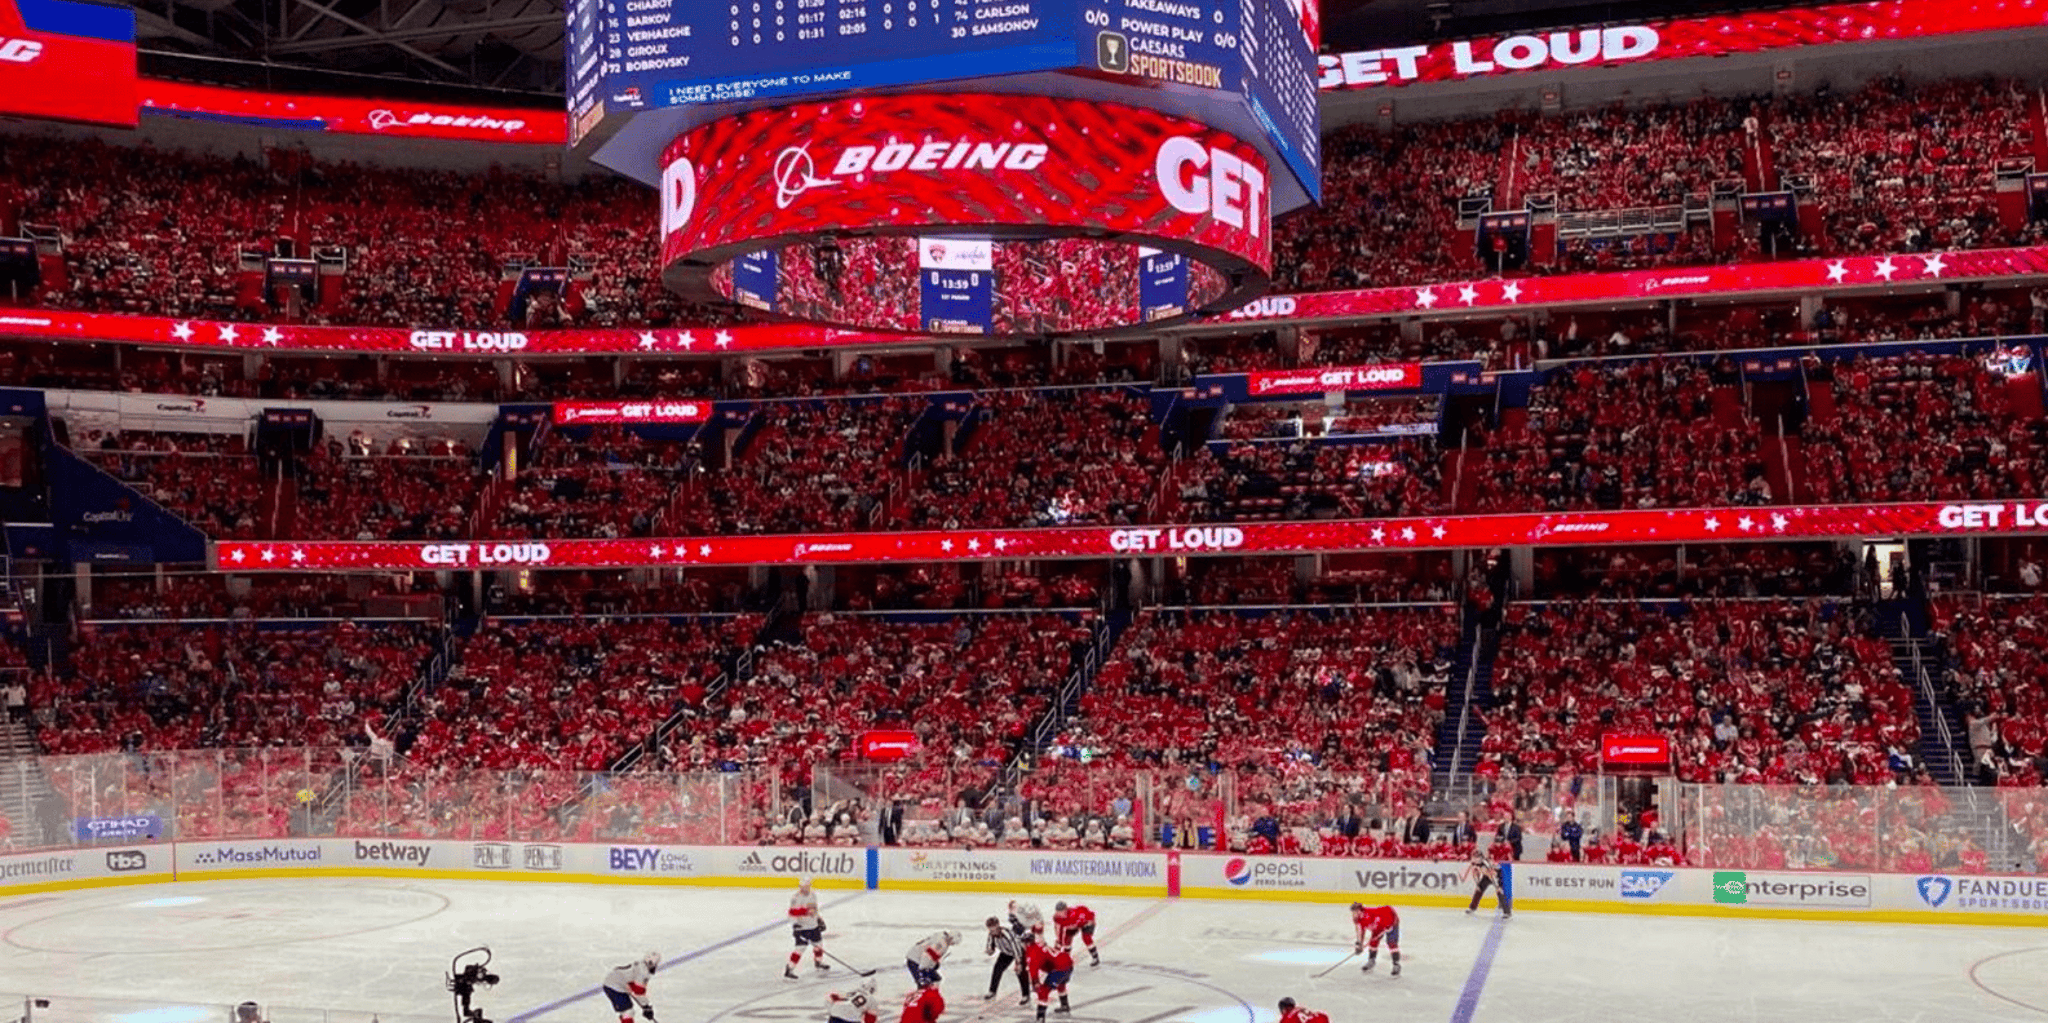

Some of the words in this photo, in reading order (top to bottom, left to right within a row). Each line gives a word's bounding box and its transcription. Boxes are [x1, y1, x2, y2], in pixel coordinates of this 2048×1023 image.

[609, 33, 621, 44] 23
[731, 20, 739, 31] 0
[753, 18, 761, 28] 0
[776, 15, 784, 26] 0
[798, 12, 825, 24] 01:17
[839, 7, 866, 19] 02:16
[884, 3, 892, 14] 0
[908, 1, 916, 11] 0
[627, 13, 671, 27] BARKOV
[730, 5, 739, 15] 0
[752, 2, 760, 13] 0
[776, 0, 784, 10] 0
[731, 36, 739, 46] 0
[753, 33, 761, 44] 0
[777, 31, 784, 41] 0
[798, 27, 825, 39] 01:31
[839, 22, 866, 35] 02:05
[884, 19, 892, 30] 0
[908, 16, 917, 27] 0
[955, 11, 968, 22] 74
[975, 3, 1030, 19] CARLSON
[1213, 10, 1223, 23] 0
[1085, 10, 1109, 26] 0/0
[1121, 17, 1169, 37] POWER
[1172, 27, 1203, 43] PLAY
[1214, 33, 1236, 48] 0/0
[609, 63, 621, 74] 72
[626, 56, 690, 72] BOBROVSKY
[951, 26, 966, 38] 30
[972, 18, 1039, 36] SAMSONOV
[1130, 37, 1185, 58] CAESARS
[1453, 25, 1660, 74] LOUD
[1131, 54, 1221, 88] SPORTSBOOK
[676, 84, 712, 95] NEED
[792, 75, 810, 84] TO
[814, 71, 851, 82] MAKE
[409, 112, 525, 132] BOEING
[833, 142, 1049, 175] BOEING
[1156, 135, 1264, 238] GET
[942, 279, 969, 290] 13:59
[410, 331, 456, 349] GET
[464, 332, 528, 350] LOUD
[1321, 371, 1354, 385] GET
[1358, 369, 1404, 383] LOUD
[622, 404, 651, 417] GET
[656, 404, 698, 417] LOUD
[1939, 504, 2005, 528] GET
[1110, 529, 1161, 550] GET
[1169, 527, 1244, 548] LOUD
[421, 544, 471, 564] GET
[479, 543, 551, 563] LOUD
[109, 853, 144, 869] tbs
[217, 846, 321, 863] MassMutual
[355, 840, 430, 867] betway
[609, 848, 661, 871] BEVY
[661, 854, 689, 862] LONG
[771, 851, 854, 874] adiclub
[1030, 858, 1053, 875] NEW
[1055, 859, 1122, 877] AMSTERDAM
[1125, 861, 1157, 878] VODKA
[1255, 861, 1304, 878] pepsi
[1355, 866, 1458, 890] verizon
[1528, 876, 1553, 887] THE
[1555, 877, 1585, 888] BEST
[1589, 878, 1615, 889] RUN
[1621, 874, 1662, 892] SAP
